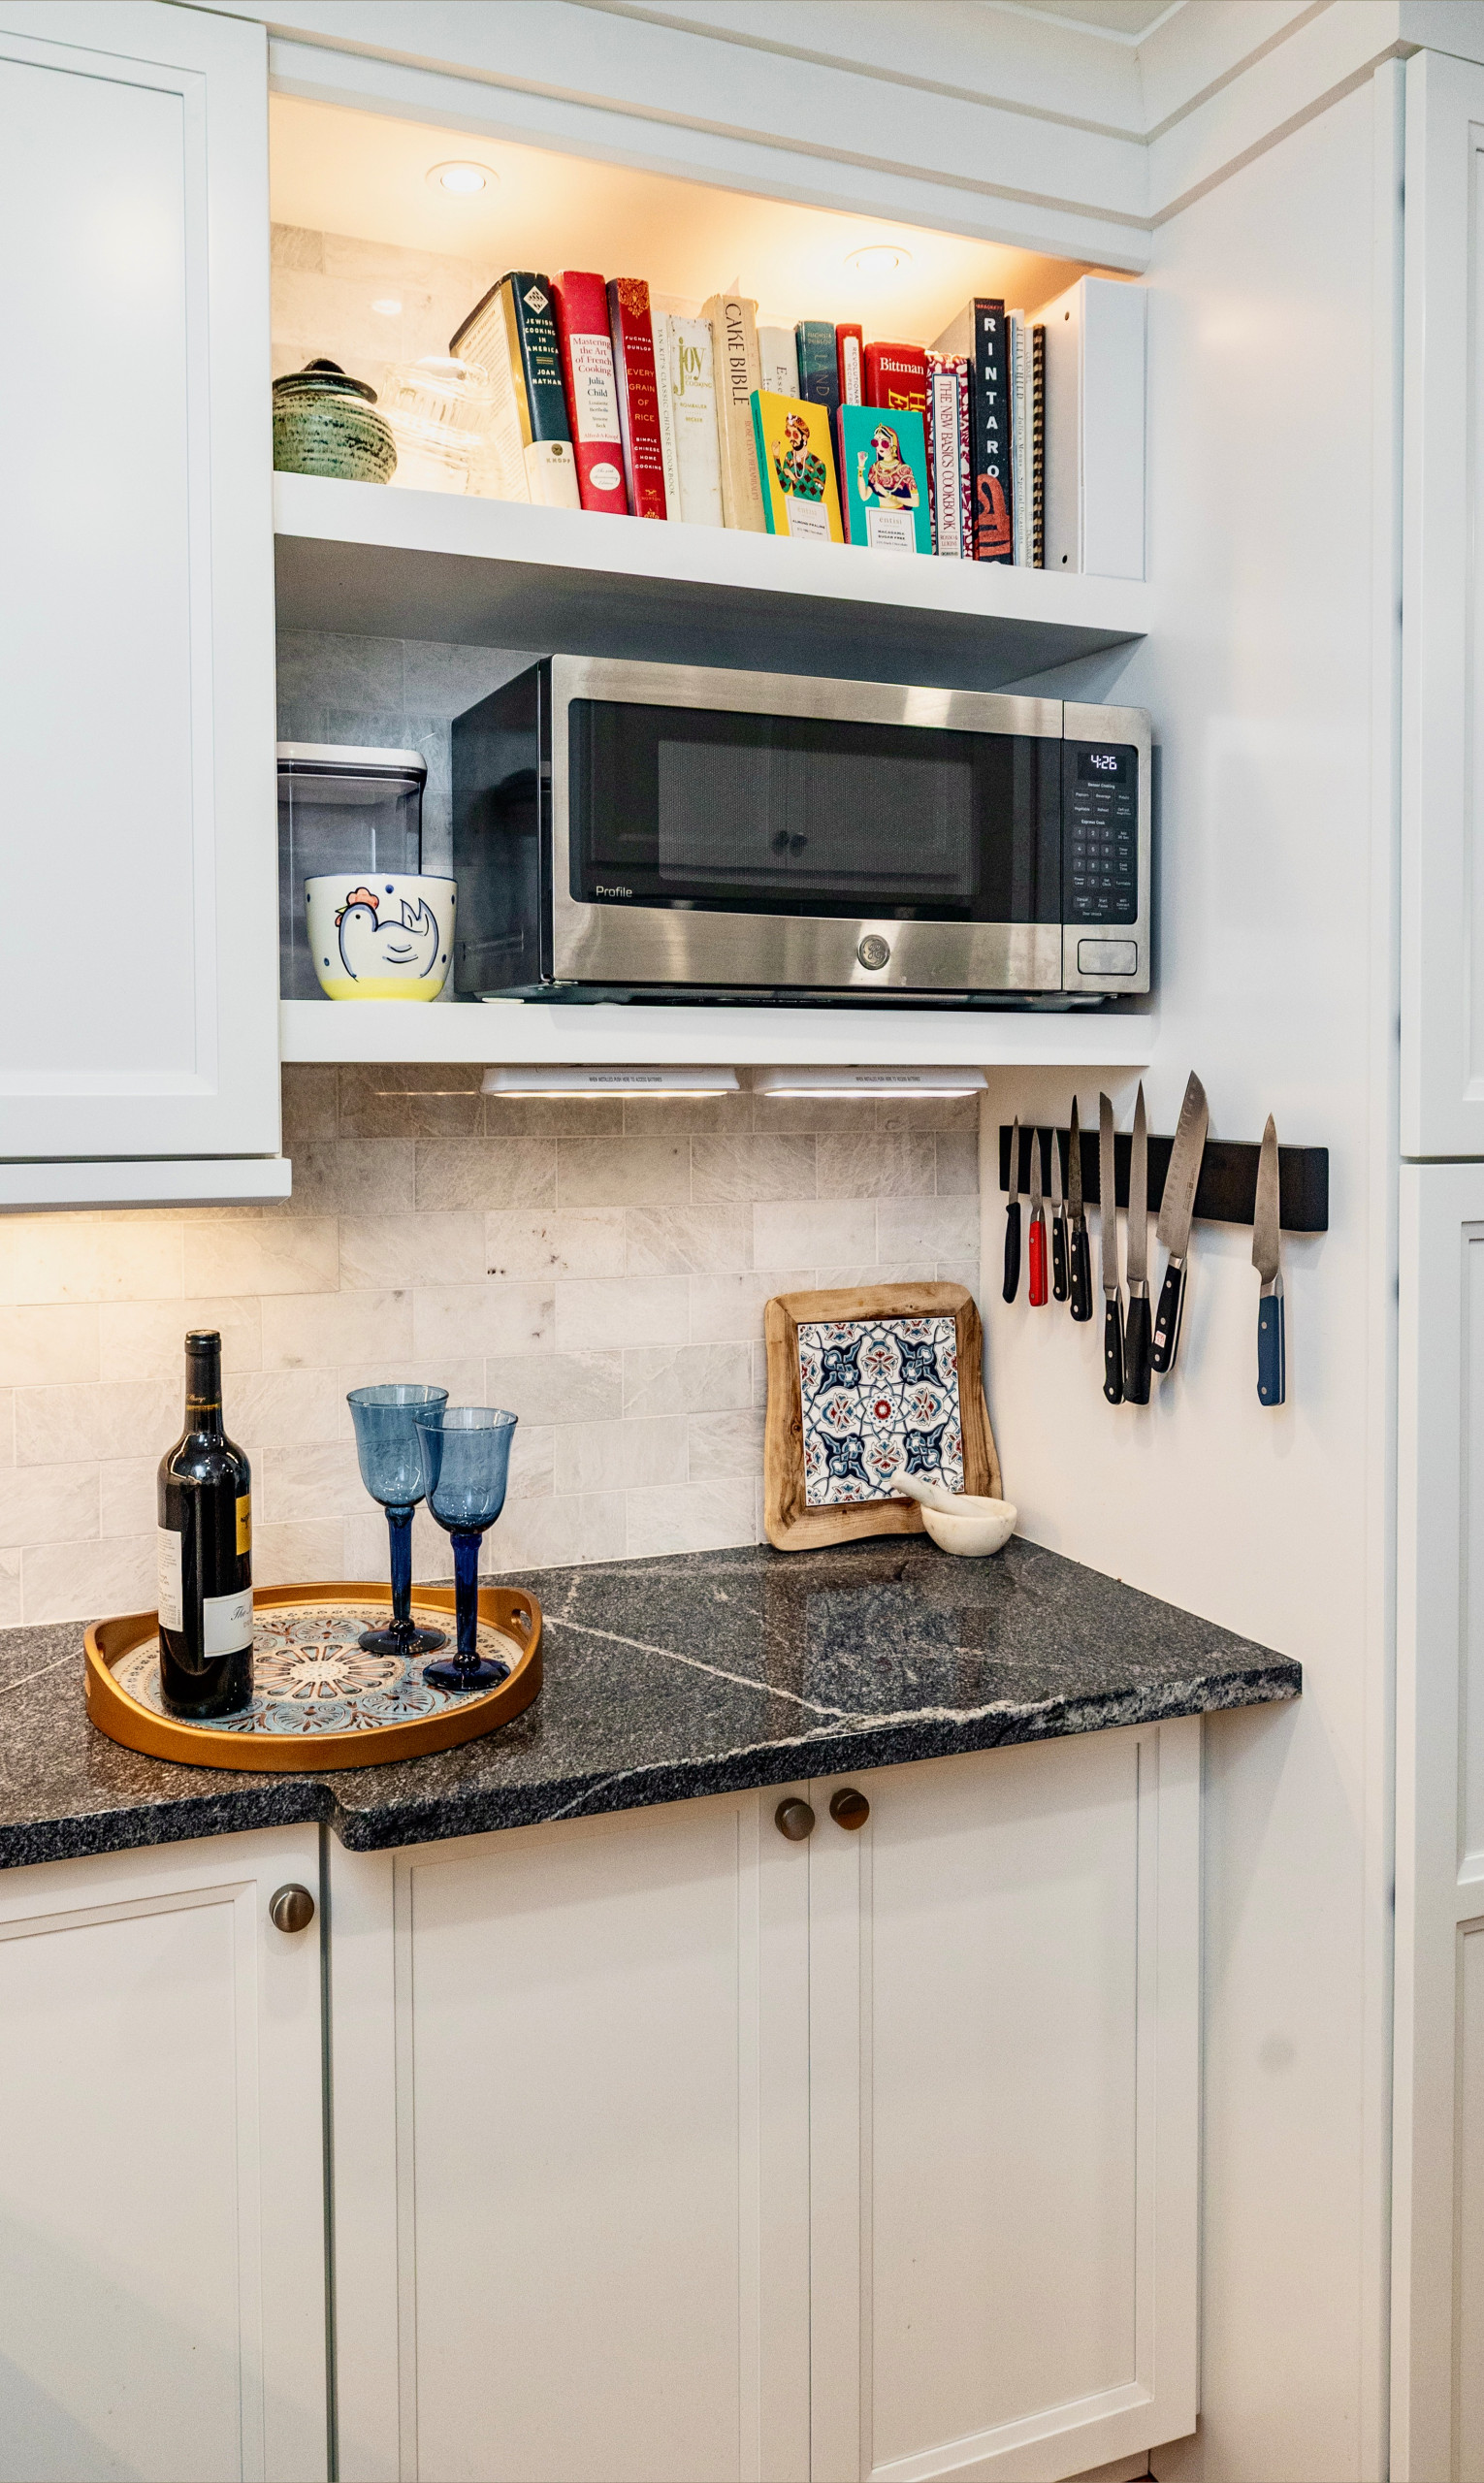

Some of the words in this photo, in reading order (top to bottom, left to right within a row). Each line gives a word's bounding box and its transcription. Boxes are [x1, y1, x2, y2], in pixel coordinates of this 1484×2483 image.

[525, 327, 556, 336] COOKING
[726, 303, 745, 352] CAKE
[572, 337, 612, 349] Mastering
[625, 335, 652, 343] FUCHSIA
[1016, 326, 1024, 360] JULIA
[527, 345, 559, 354] AMERICA
[579, 346, 594, 355] the
[595, 347, 607, 356] Art
[587, 356, 612, 366] French
[879, 356, 924, 375] Bittman
[578, 365, 612, 376] Cooking
[627, 368, 655, 377] EVERY
[815, 354, 830, 396] LAND
[588, 376, 605, 386] Julia
[629, 383, 656, 393] GRAIN
[685, 380, 713, 389] COOKING
[729, 358, 750, 405] BIBLE
[1016, 364, 1024, 399] CHILD
[587, 389, 608, 398] Child
[661, 371, 669, 408] CLASSIC
[940, 380, 952, 403] THE
[984, 317, 1000, 478] RINTARO
[634, 413, 656, 422] RICE
[940, 405, 953, 430] NEW
[663, 409, 672, 446] CHINESE
[941, 433, 954, 468] BASICS
[666, 448, 676, 496] COOKBOOK
[942, 470, 956, 531] COOKBOOK
[1090, 754, 1117, 770] 4:26
[596, 885, 633, 898] Profile
